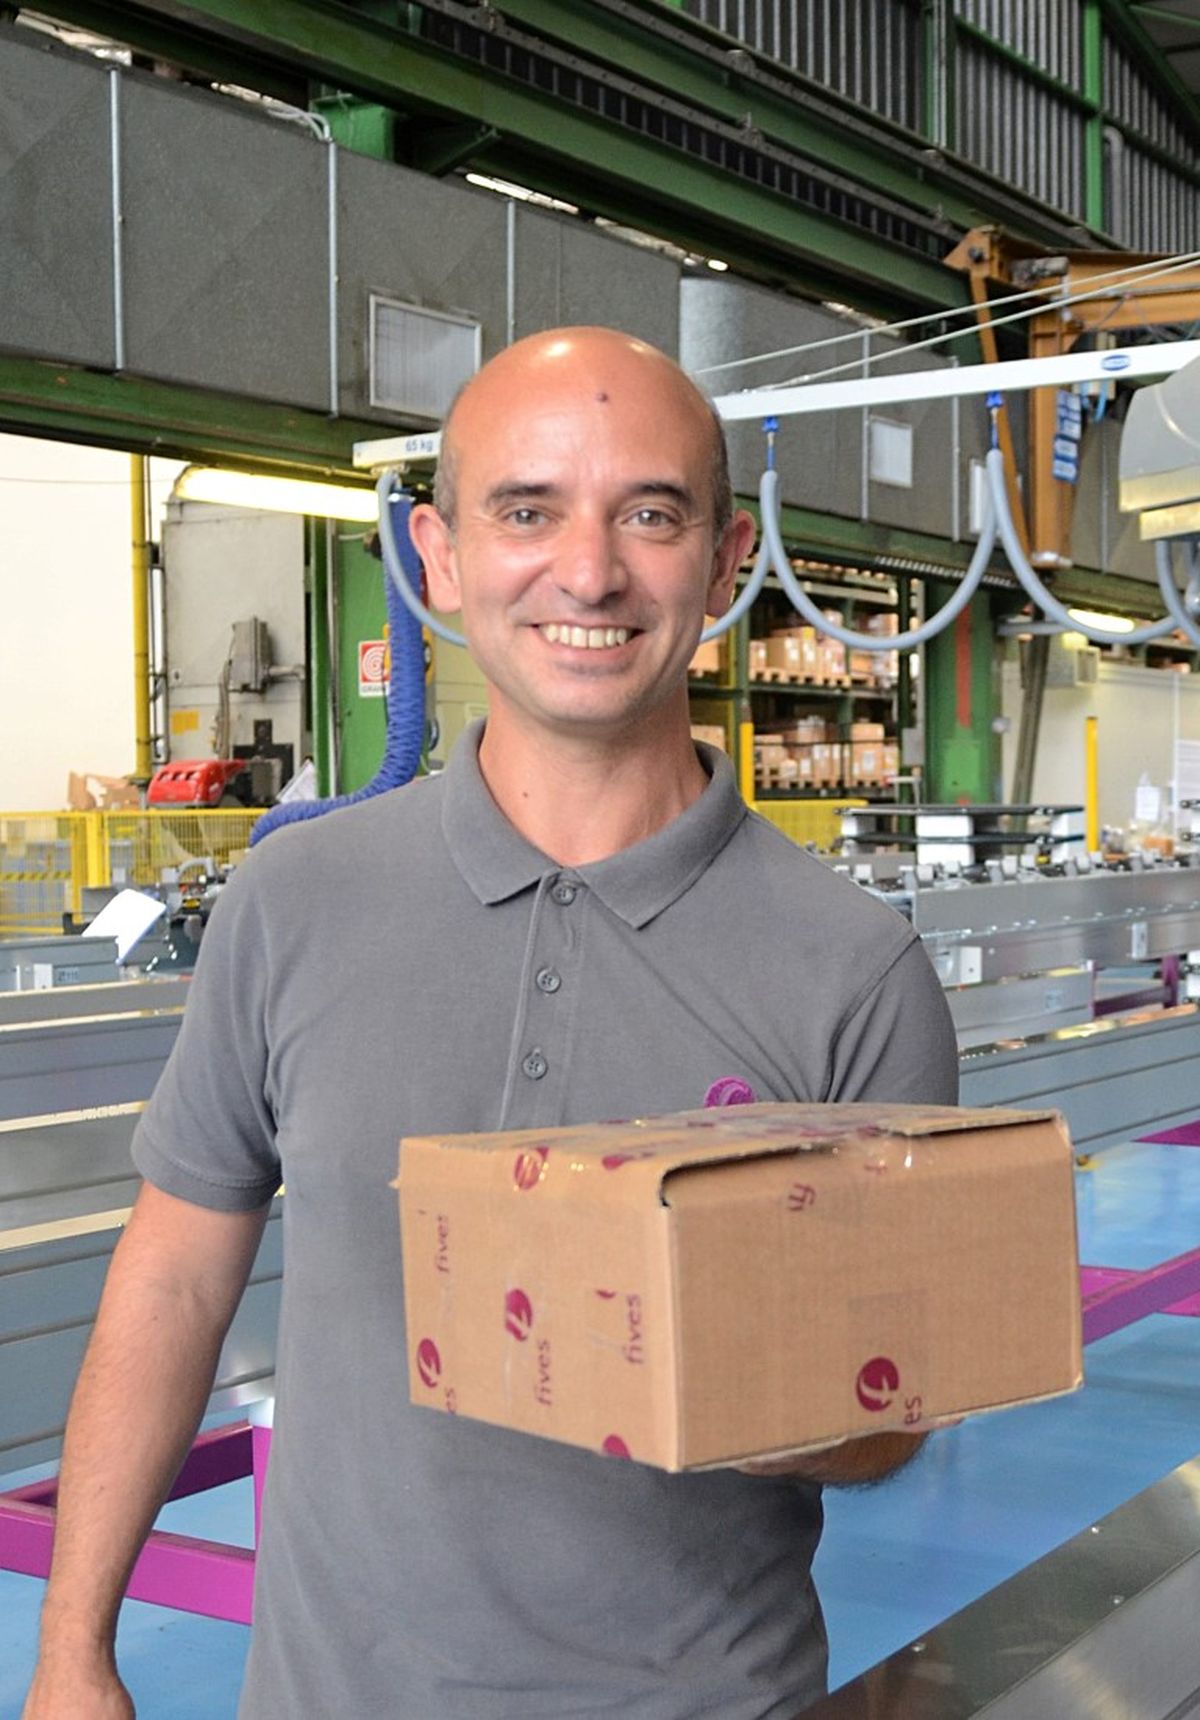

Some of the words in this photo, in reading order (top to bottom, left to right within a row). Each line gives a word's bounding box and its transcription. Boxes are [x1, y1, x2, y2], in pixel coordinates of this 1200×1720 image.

[405, 439, 417, 451] 65
[420, 439, 433, 452] kg
[622, 1294, 644, 1363] fives
[534, 1338, 551, 1405] fives
